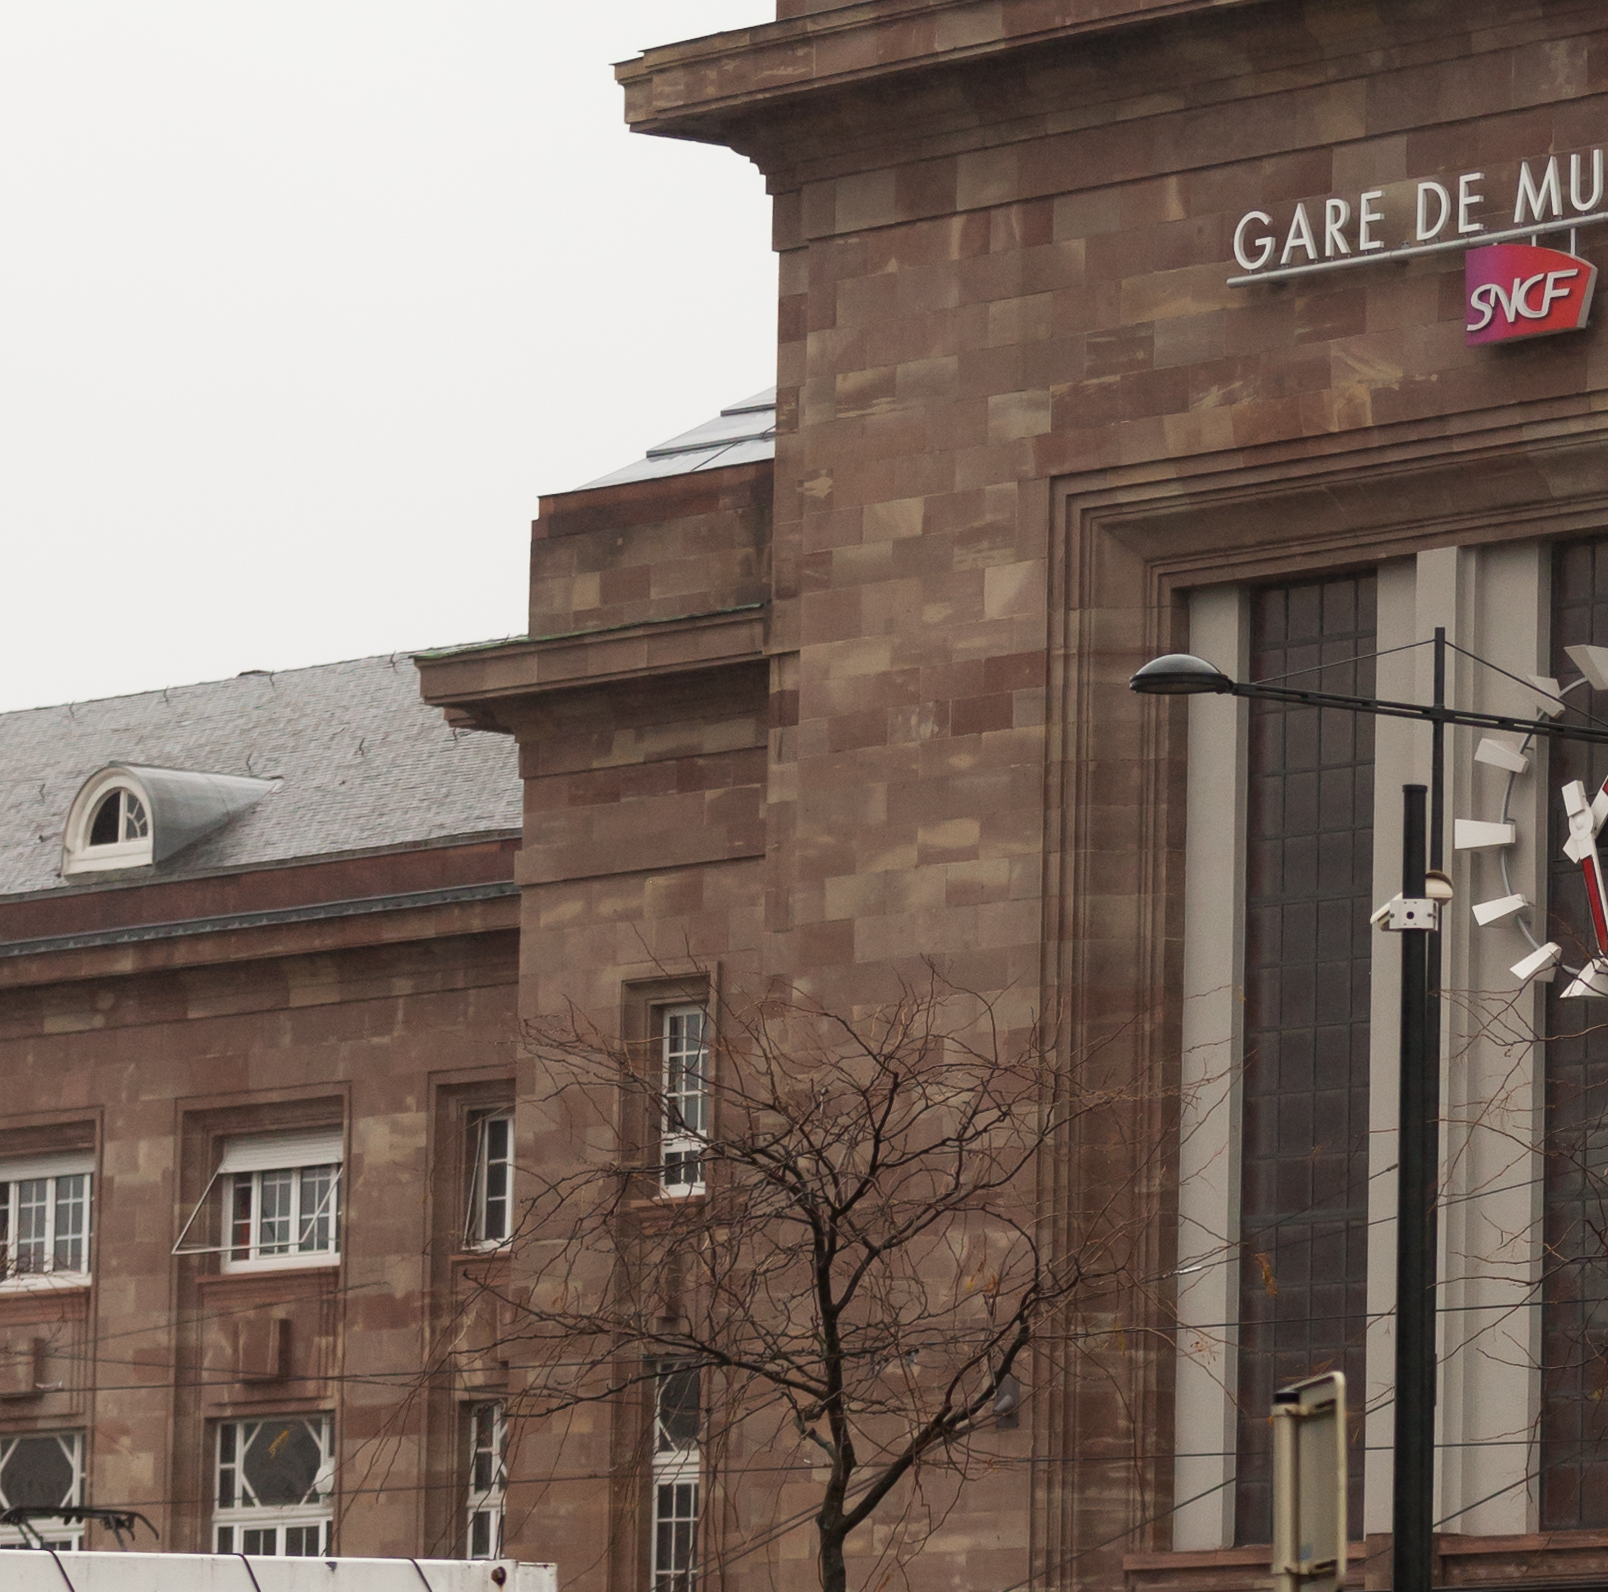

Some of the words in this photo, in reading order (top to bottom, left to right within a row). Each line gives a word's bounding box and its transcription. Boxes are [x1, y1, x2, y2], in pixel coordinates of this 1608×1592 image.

[1232, 189, 1386, 271] GARE
[1416, 171, 1487, 242] DE
[1466, 267, 1581, 334] SNCF
